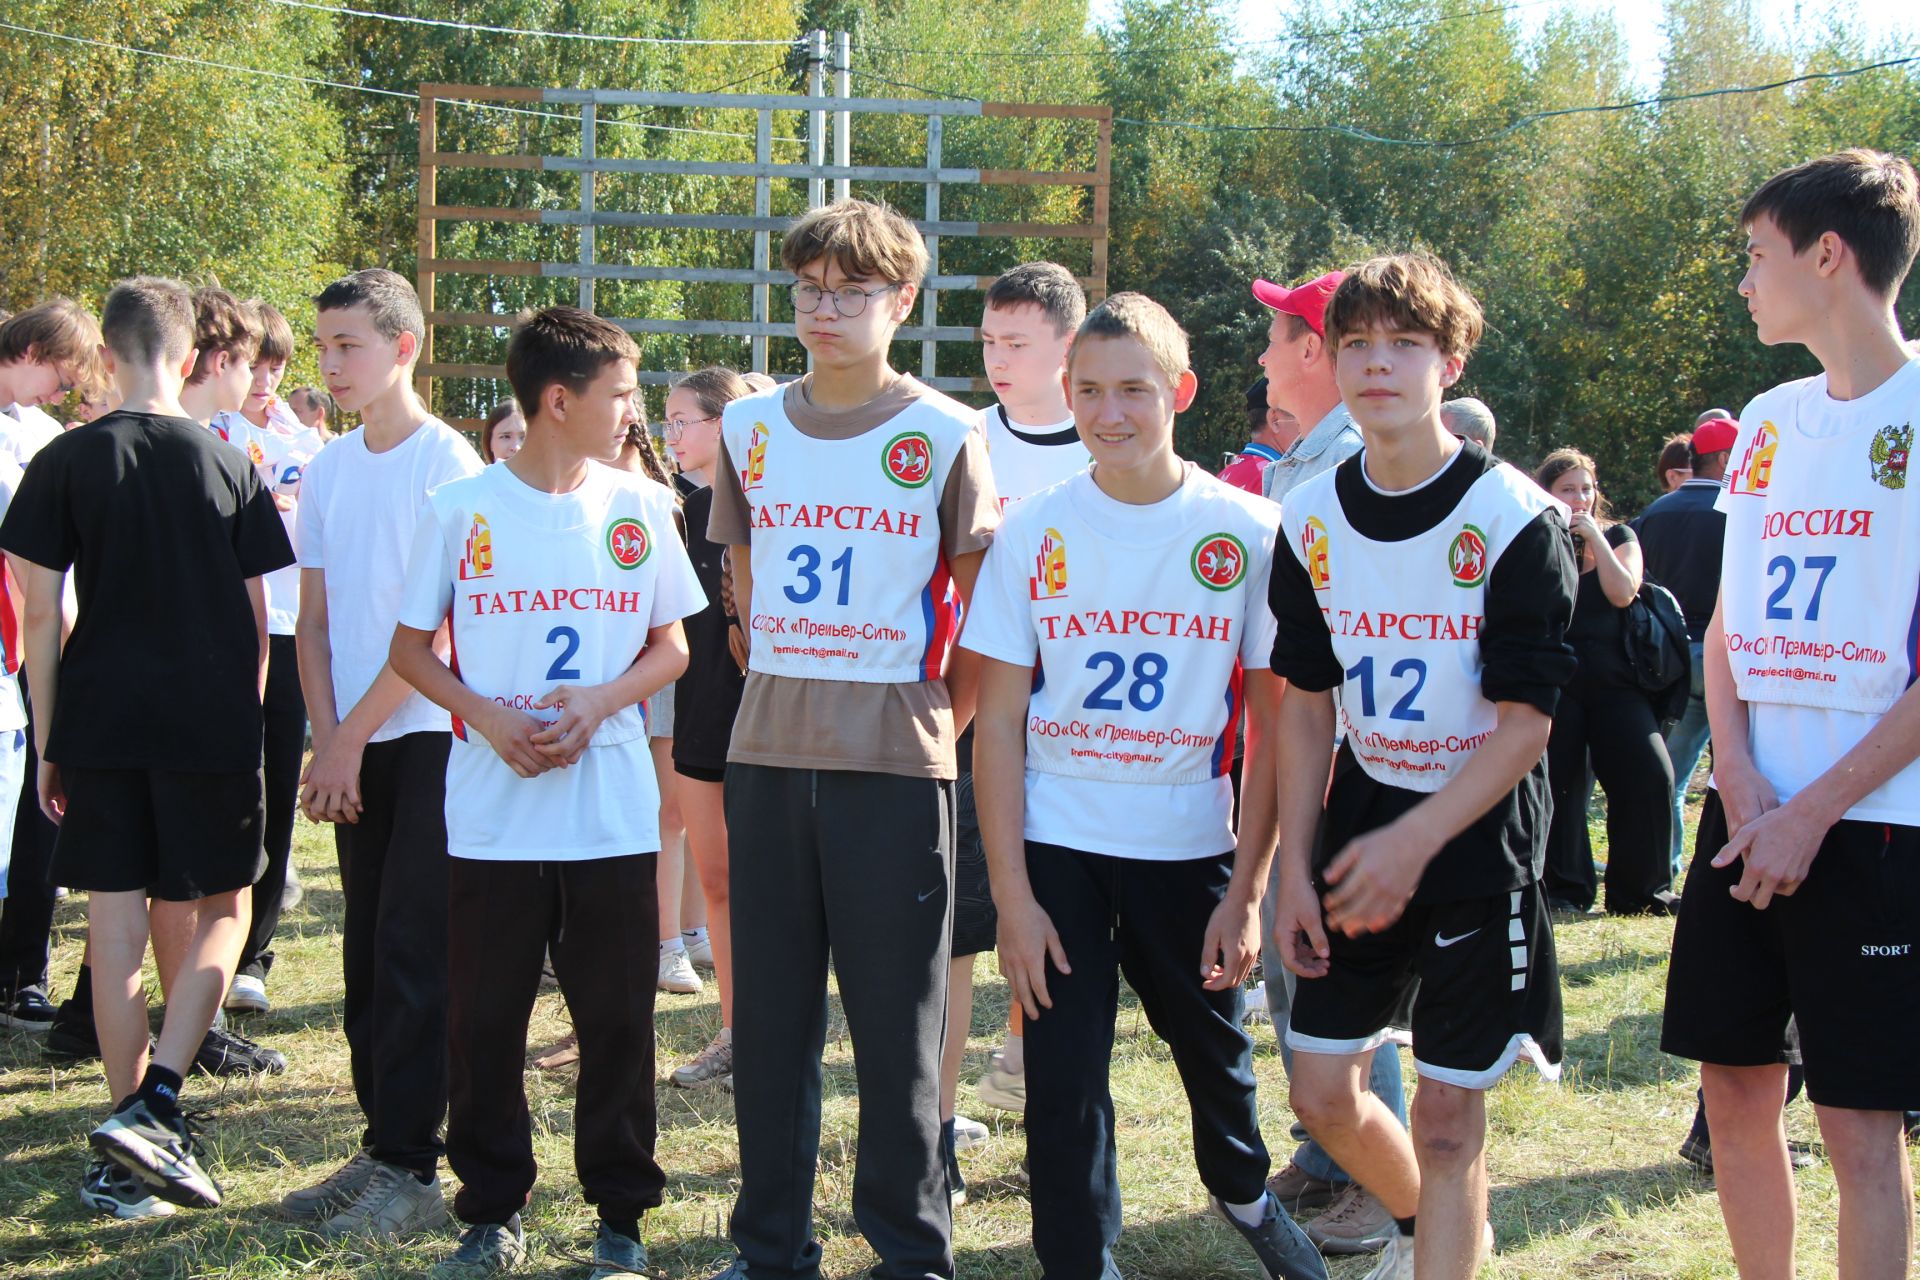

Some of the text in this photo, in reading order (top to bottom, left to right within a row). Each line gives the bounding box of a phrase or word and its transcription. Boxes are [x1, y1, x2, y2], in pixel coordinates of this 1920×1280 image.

[469, 588, 641, 616] ТАТАРСТАН
[783, 545, 854, 606] 31
[1766, 555, 1837, 622] 27
[545, 625, 581, 681] 2
[1320, 607, 1485, 641] ТАРСТАН
[1082, 651, 1169, 712] 28
[1346, 655, 1427, 722] 12
[1861, 943, 1912, 956] SPORT
